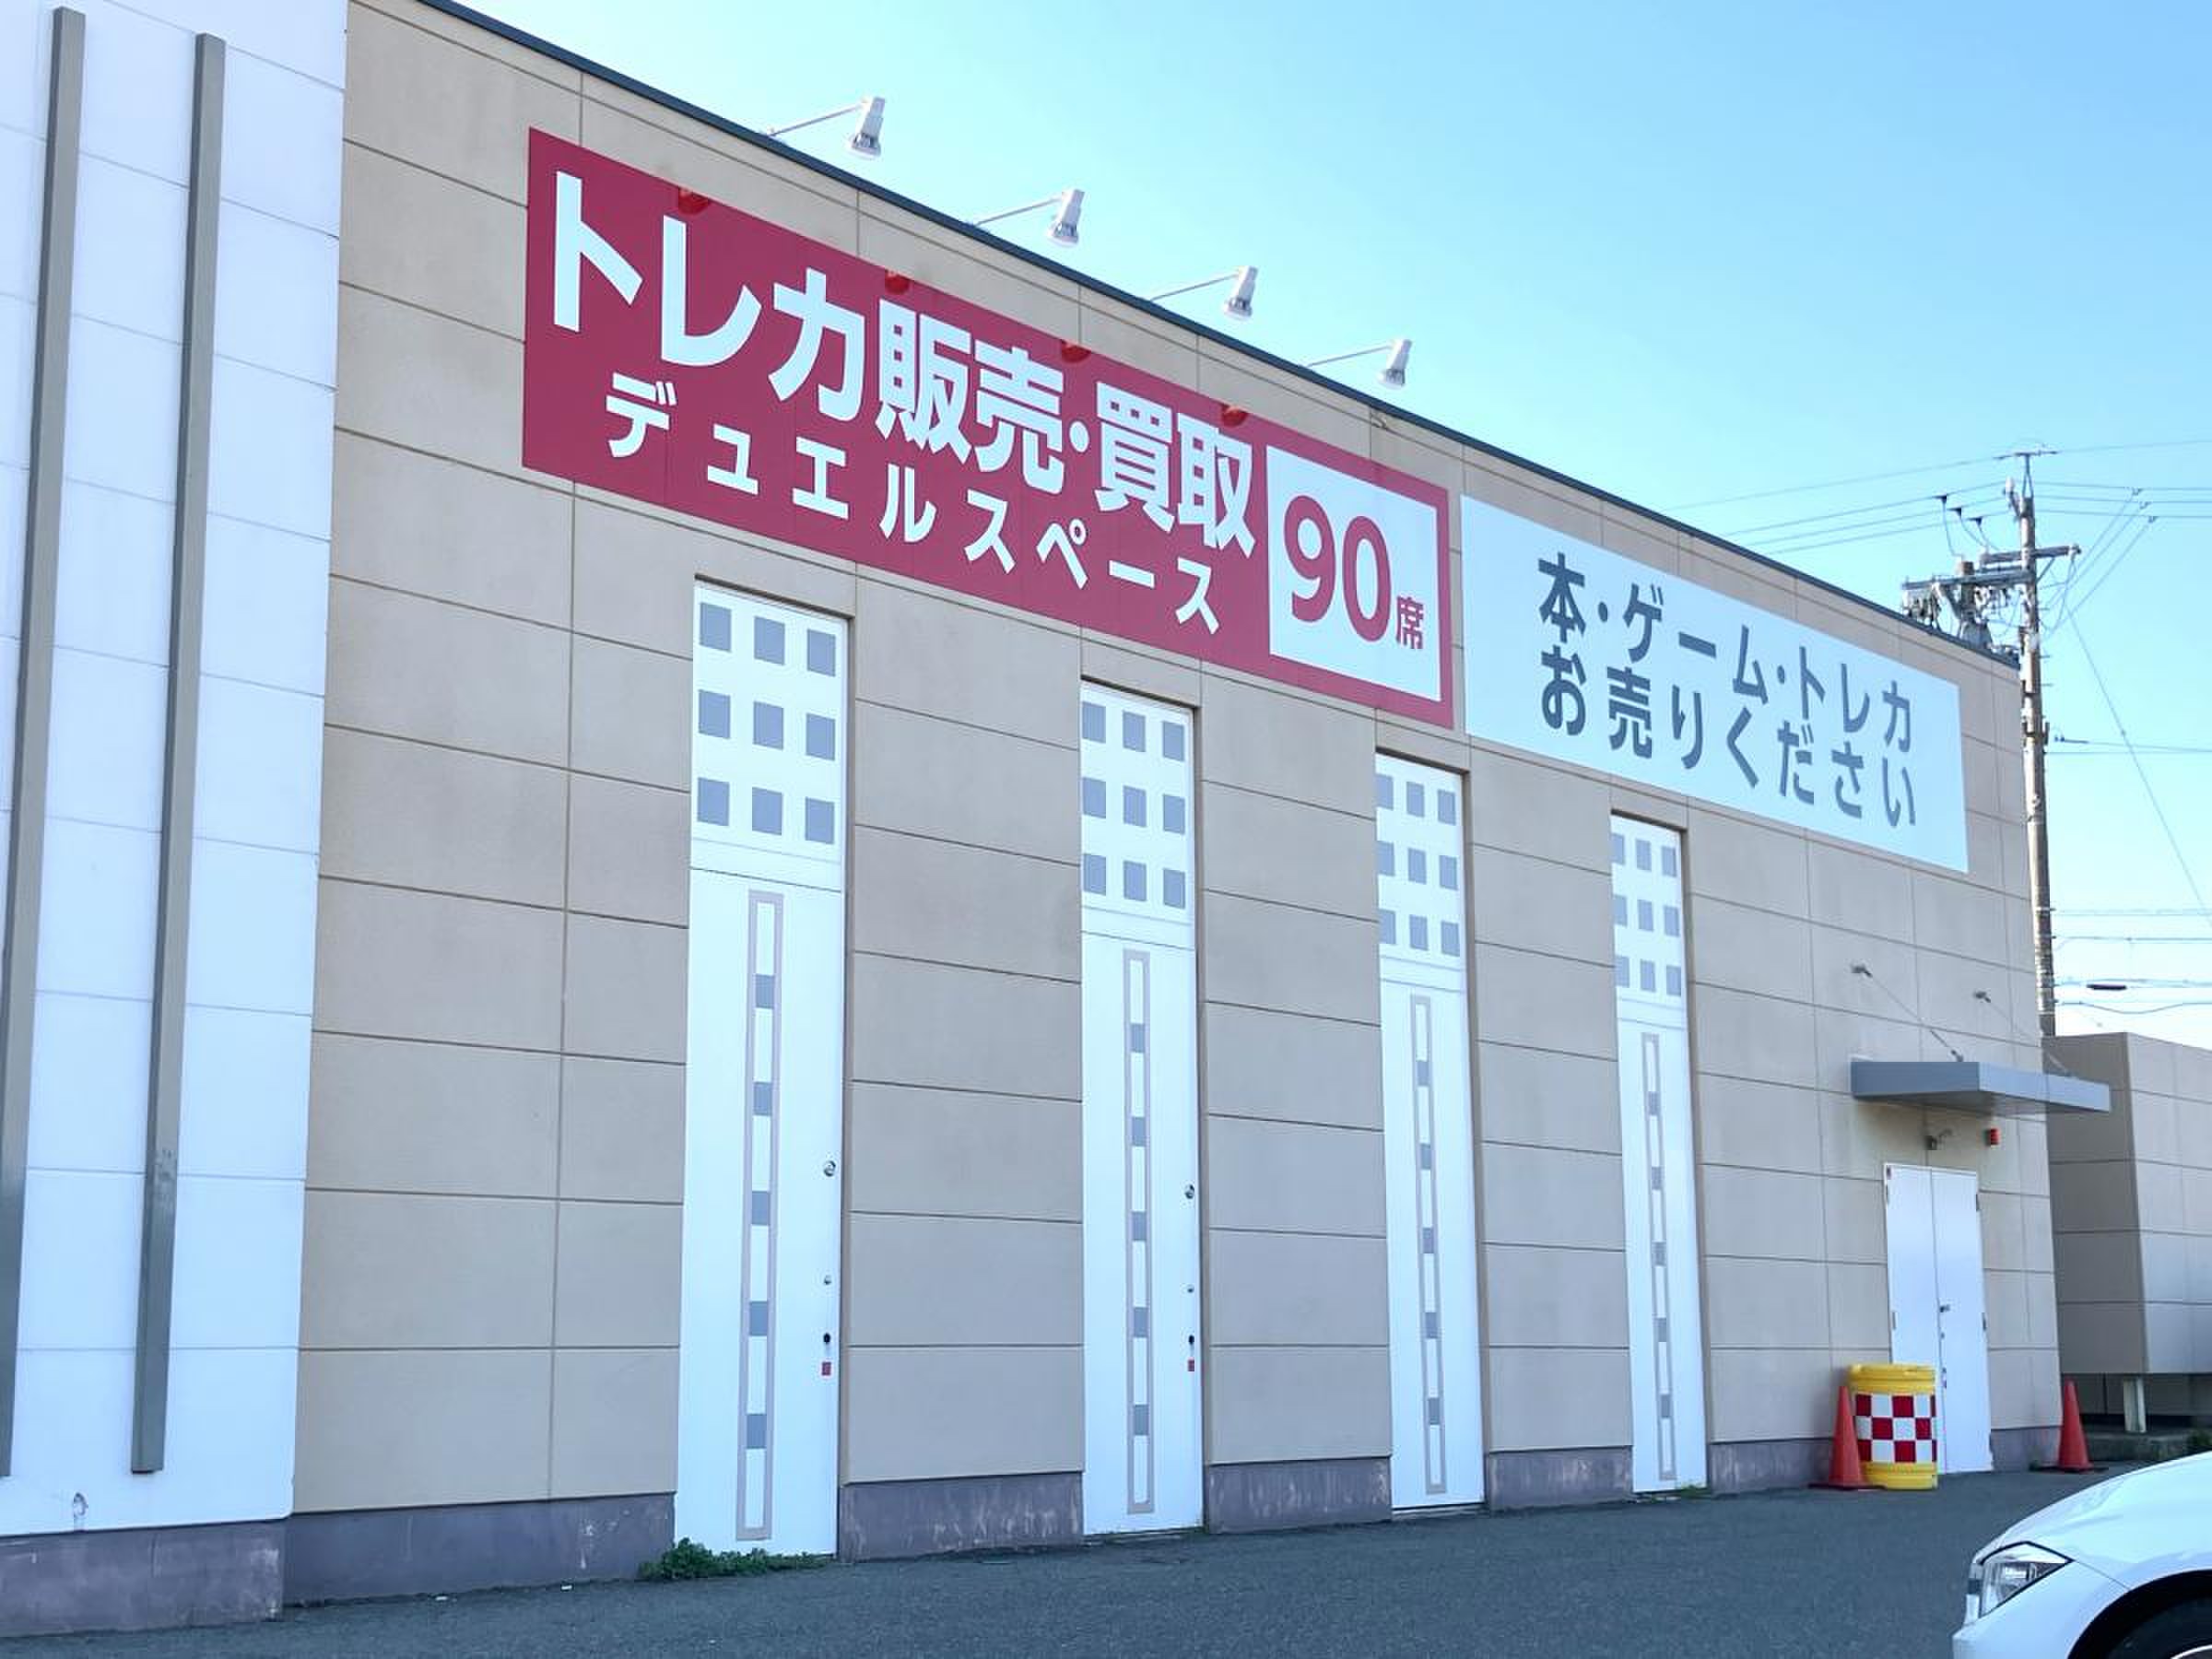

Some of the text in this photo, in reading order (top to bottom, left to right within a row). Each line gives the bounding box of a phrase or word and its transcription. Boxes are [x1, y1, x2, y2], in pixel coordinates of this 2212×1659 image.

[554, 171, 1255, 558] トレカ販売・買取
[606, 372, 1219, 634] デュエルスペース
[1538, 553, 1912, 753] 本・ゲーム・トレカ
[1542, 646, 1915, 827] お売りください
